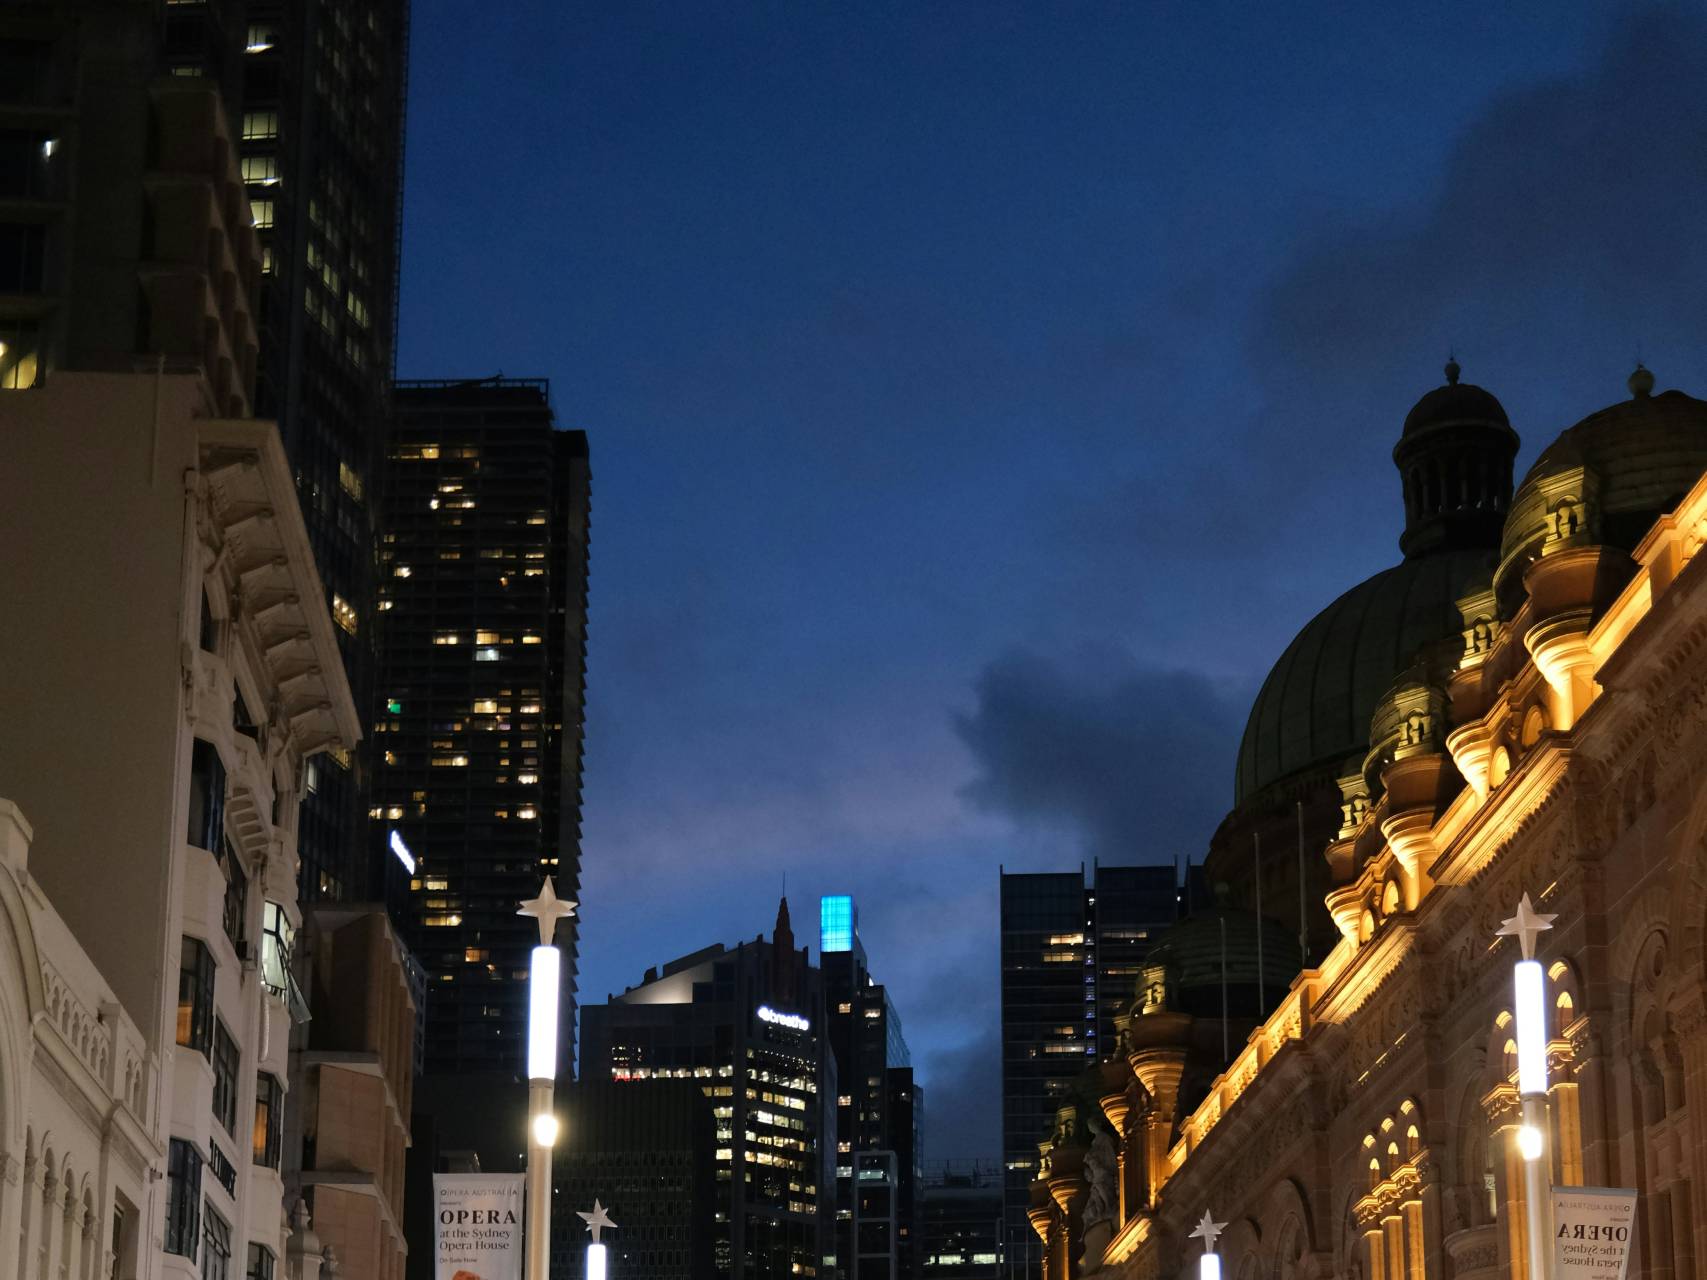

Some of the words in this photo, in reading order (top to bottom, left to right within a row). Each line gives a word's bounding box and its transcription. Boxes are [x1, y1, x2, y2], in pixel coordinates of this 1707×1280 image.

[440, 1209, 517, 1225] OPERA
[440, 1230, 449, 1238] at
[452, 1228, 470, 1238] the
[472, 1229, 512, 1240] Sydney
[439, 1241, 473, 1252] Opera
[475, 1241, 510, 1250] House
